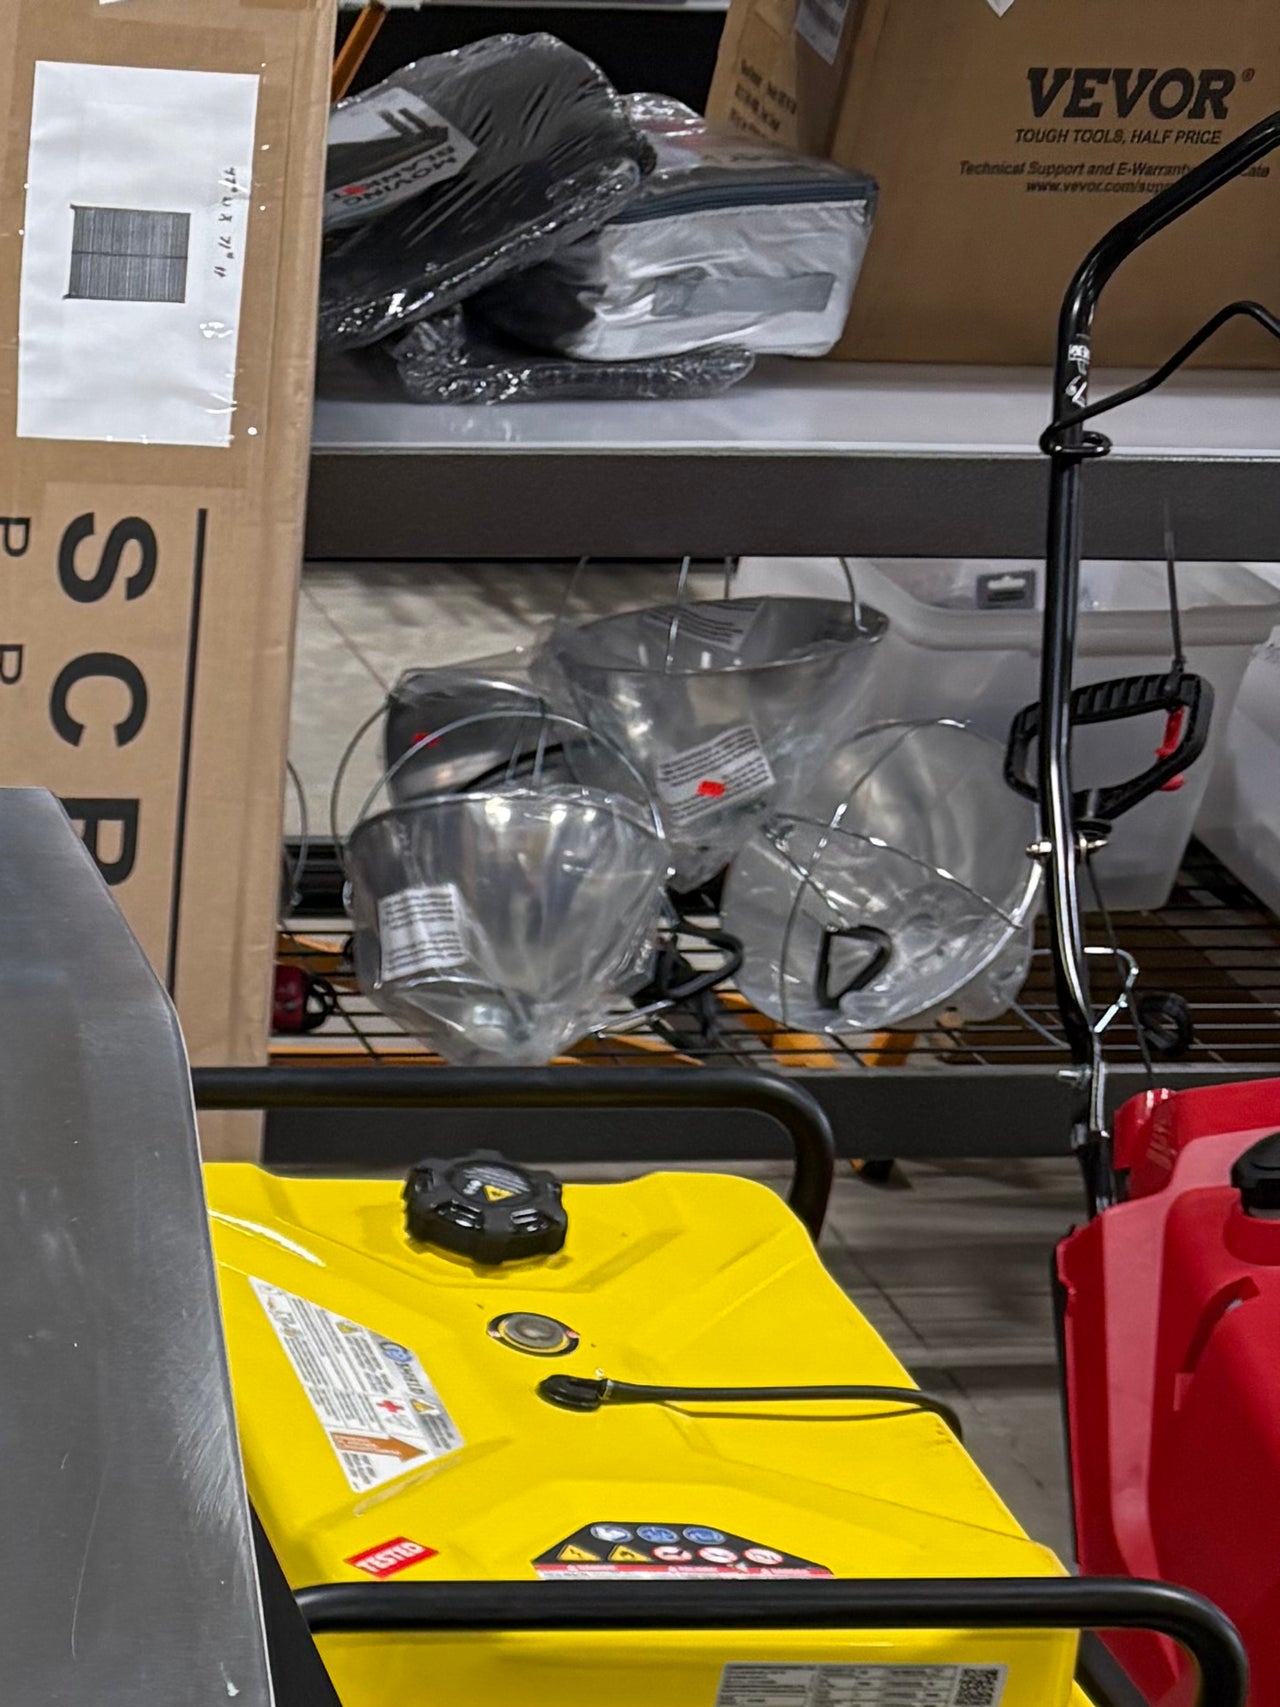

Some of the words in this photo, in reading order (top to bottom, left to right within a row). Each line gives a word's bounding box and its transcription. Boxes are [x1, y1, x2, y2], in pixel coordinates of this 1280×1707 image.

[1027, 67, 1237, 120] VEVOR
[1015, 129, 1068, 144] TOUGH
[1073, 130, 1126, 145] TOOLS,
[1131, 130, 1172, 144] HALF
[1175, 130, 1222, 144] PRICE
[960, 161, 1026, 175] Technical
[1027, 161, 1085, 178] Support
[1089, 161, 1114, 175] and
